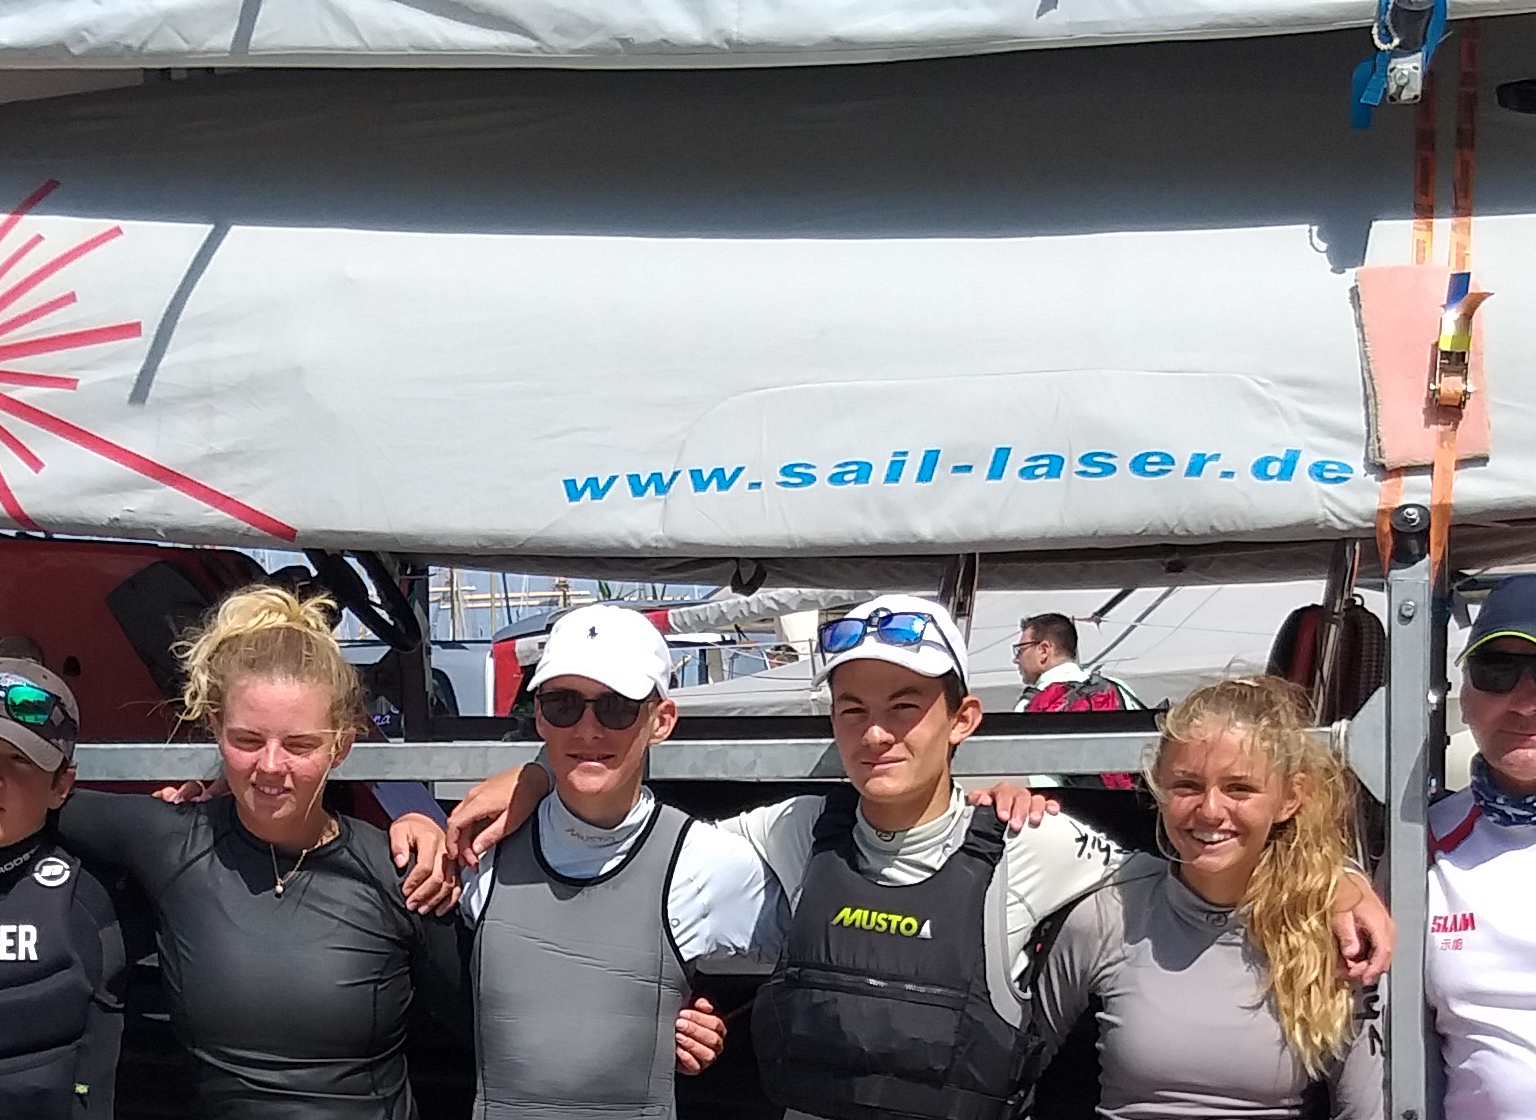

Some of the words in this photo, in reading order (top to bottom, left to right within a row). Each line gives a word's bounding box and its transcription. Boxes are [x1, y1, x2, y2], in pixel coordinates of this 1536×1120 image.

[562, 445, 1356, 505] www.sail-laser.de
[830, 907, 919, 938] MUSTO
[1430, 912, 1476, 933] SLAM
